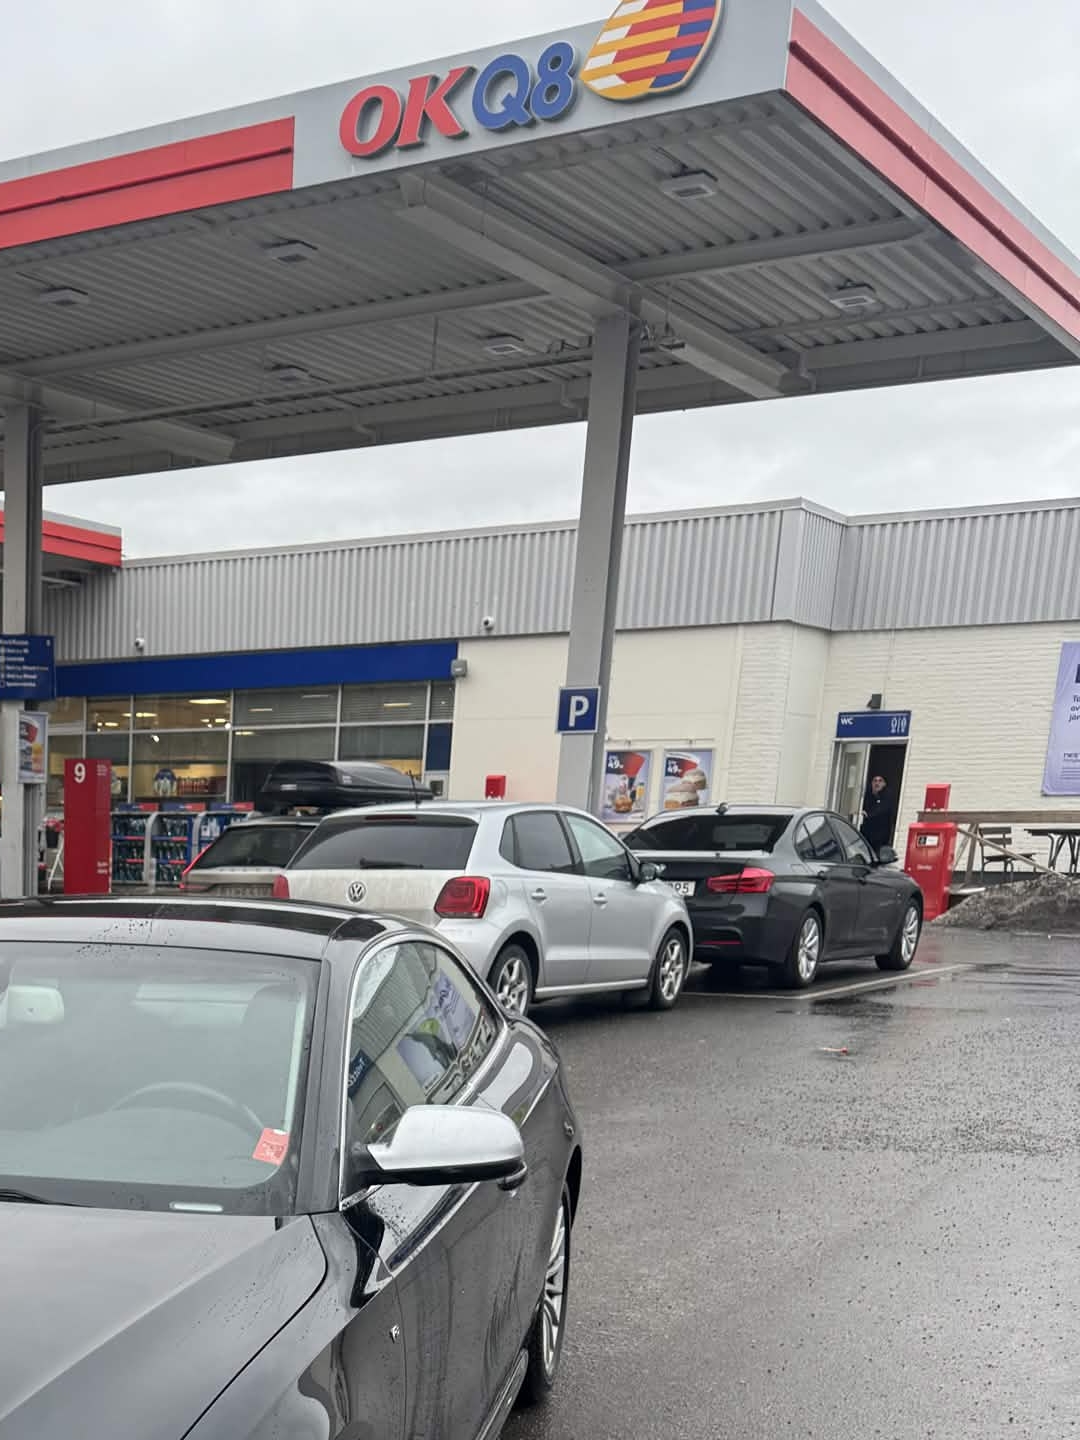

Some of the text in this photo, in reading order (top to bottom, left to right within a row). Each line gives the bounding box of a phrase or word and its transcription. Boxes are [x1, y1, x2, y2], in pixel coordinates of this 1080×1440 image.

[338, 41, 576, 157] OKQ8
[568, 695, 590, 727] P
[840, 717, 854, 725] WC
[73, 762, 86, 784] 9
